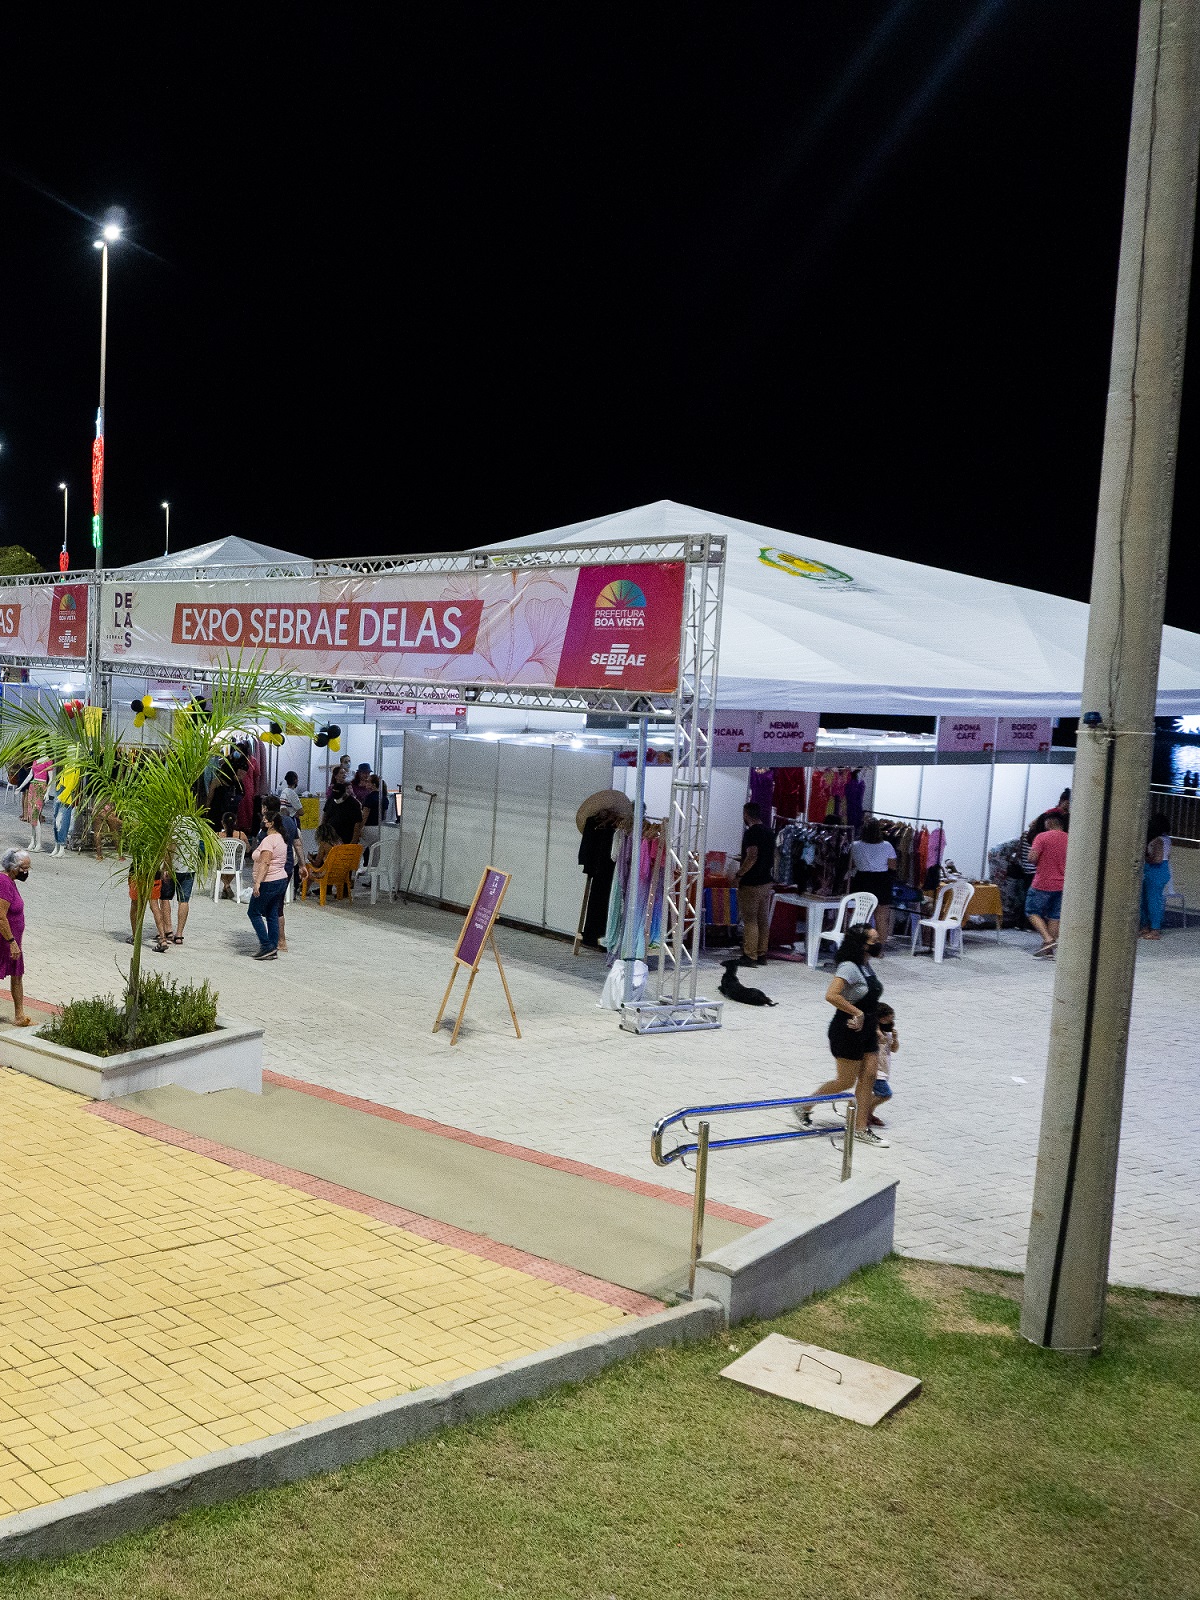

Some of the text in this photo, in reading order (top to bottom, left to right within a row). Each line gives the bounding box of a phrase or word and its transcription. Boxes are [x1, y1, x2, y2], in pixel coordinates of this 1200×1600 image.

[594, 609, 646, 618] PREFEITURA
[181, 605, 463, 649] EXPO SEBRAE DELAS
[594, 618, 645, 627] BOA VISTA
[58, 635, 78, 643] SEBRAE
[590, 652, 647, 667] SEBRAE
[769, 721, 800, 729] MENINA
[952, 723, 981, 732] AROMA
[763, 731, 805, 739] DO CAMPO
[1012, 731, 1035, 740] JOIAS
